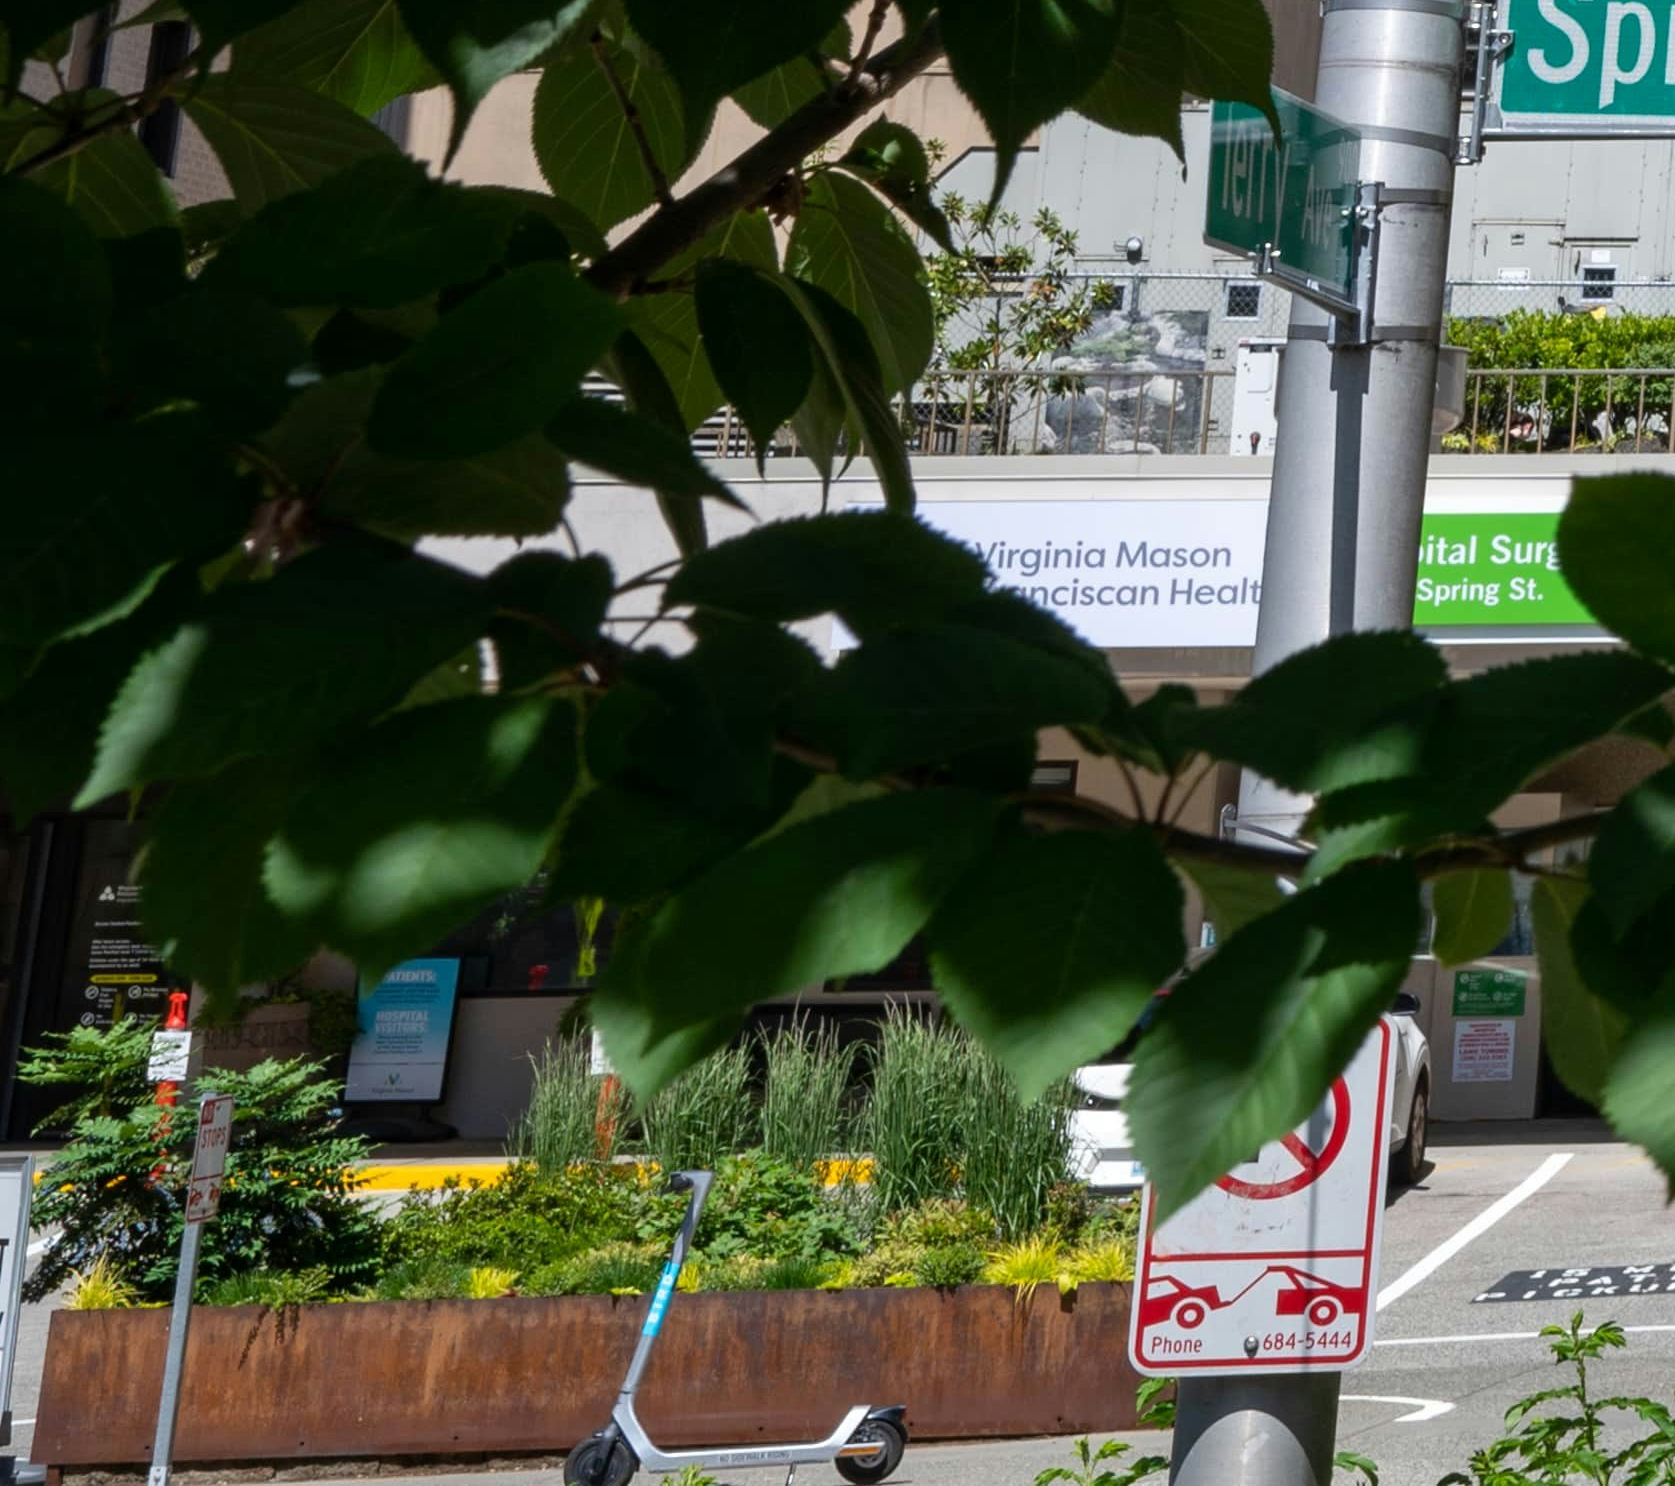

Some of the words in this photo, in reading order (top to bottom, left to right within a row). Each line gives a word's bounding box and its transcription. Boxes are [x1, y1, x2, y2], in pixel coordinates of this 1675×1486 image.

[975, 540, 1105, 577] Virginia
[1115, 541, 1232, 568] Mason
[1418, 534, 1477, 565] ital
[1490, 534, 1560, 571] Surg
[988, 577, 1159, 607] anciscan
[1169, 577, 1262, 605] Healt
[1416, 577, 1500, 607] Spring
[1509, 576, 1544, 601] St.
[1151, 1336, 1203, 1354] Phone
[1263, 1331, 1352, 1350] 684-5444
